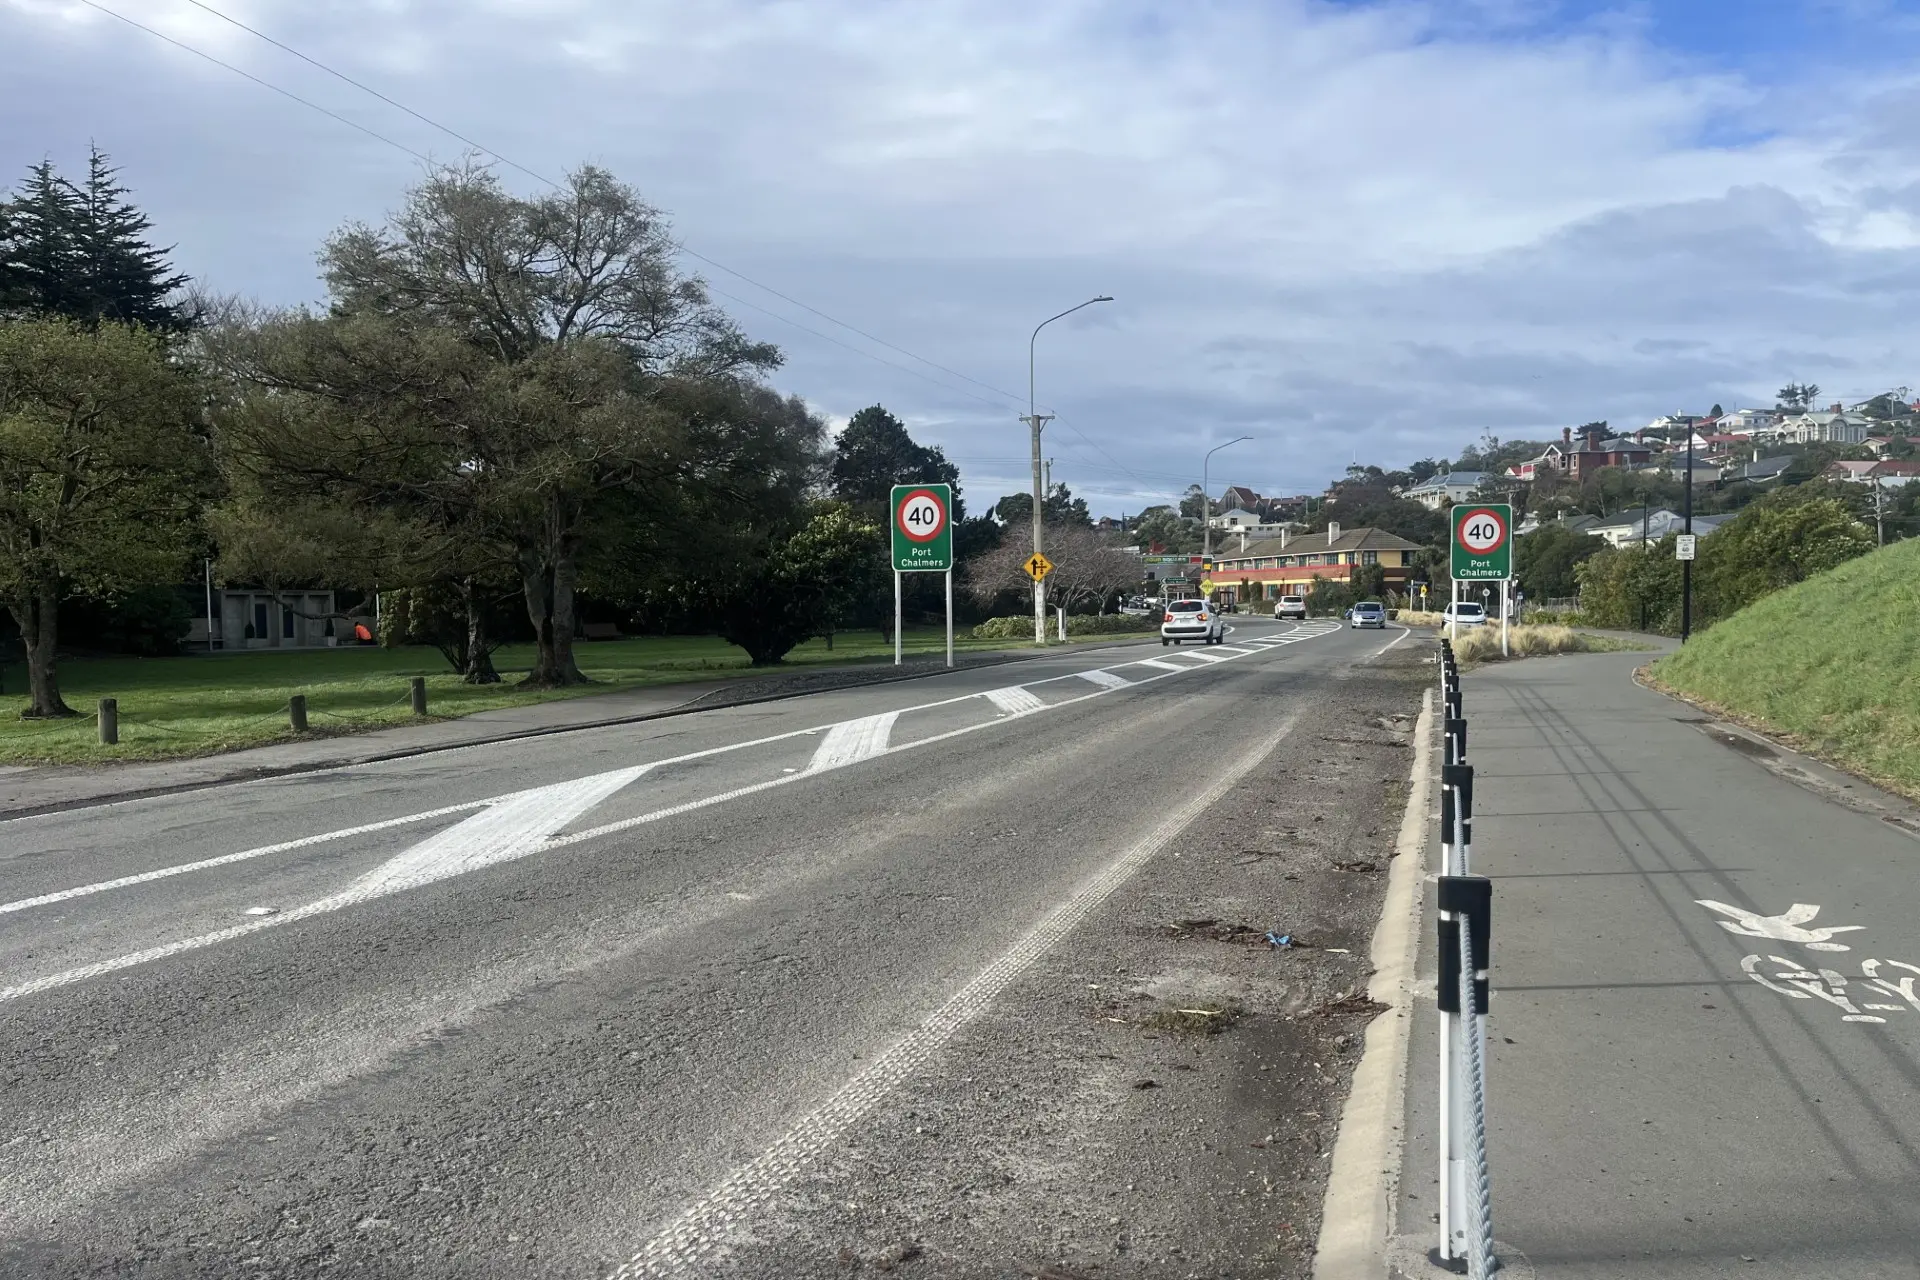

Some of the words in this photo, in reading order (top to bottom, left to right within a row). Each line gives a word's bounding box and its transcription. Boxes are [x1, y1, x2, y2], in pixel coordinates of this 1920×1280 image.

[908, 506, 934, 525] 40
[1468, 523, 1494, 540] 40
[911, 548, 932, 556] Port
[901, 558, 944, 566] Chalmers
[1460, 568, 1502, 576] Chalmers
